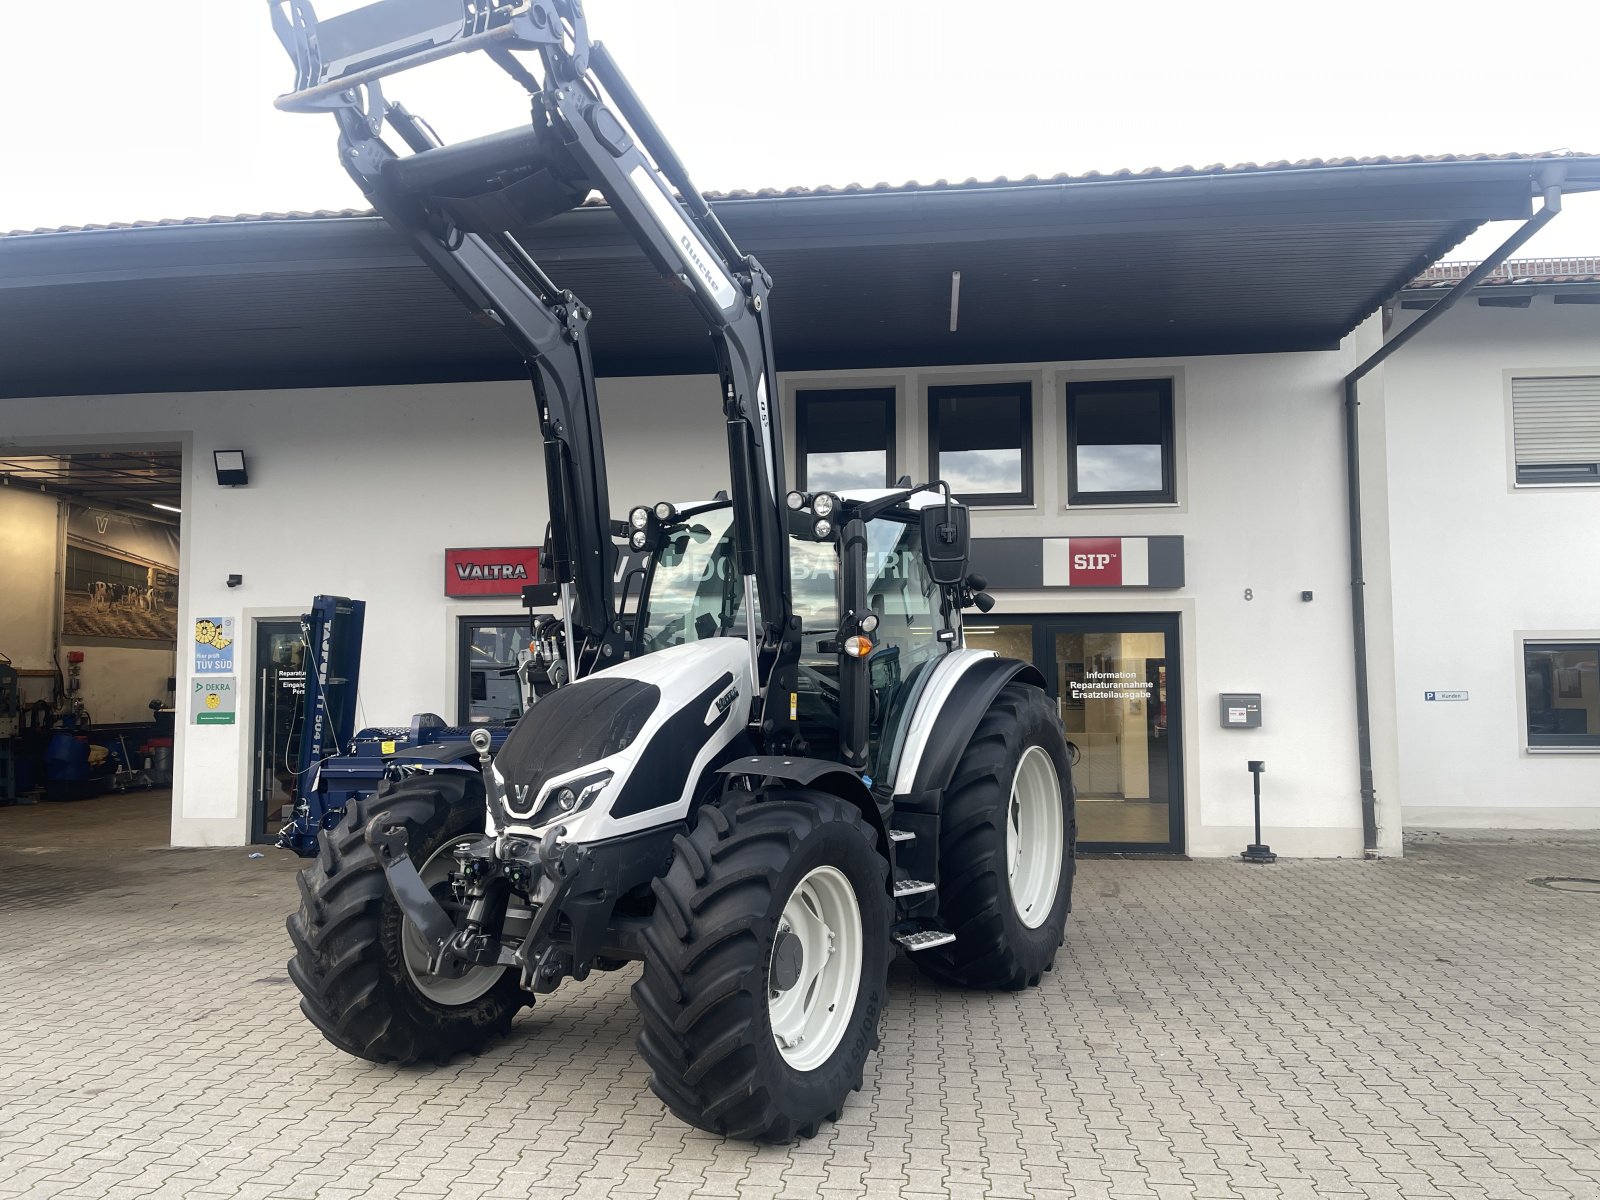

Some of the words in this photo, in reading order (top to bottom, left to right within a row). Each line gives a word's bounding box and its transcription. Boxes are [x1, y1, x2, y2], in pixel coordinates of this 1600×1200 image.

[681, 235, 719, 291] Quicke
[1074, 553, 1110, 570] SIP
[455, 562, 527, 581] VALTRA
[1244, 588, 1254, 601] 8
[319, 620, 332, 685] TAJFUN
[196, 658, 213, 670] TÜV
[214, 658, 233, 670] SÜD
[1086, 671, 1137, 679] Information
[205, 683, 231, 691] DEKRA
[1070, 681, 1154, 690] Reparaturannahme
[1072, 690, 1151, 699] Ersatzteilausgabe
[314, 714, 323, 740] 504
[312, 744, 320, 755] R
[851, 990, 879, 1064] 480/65
